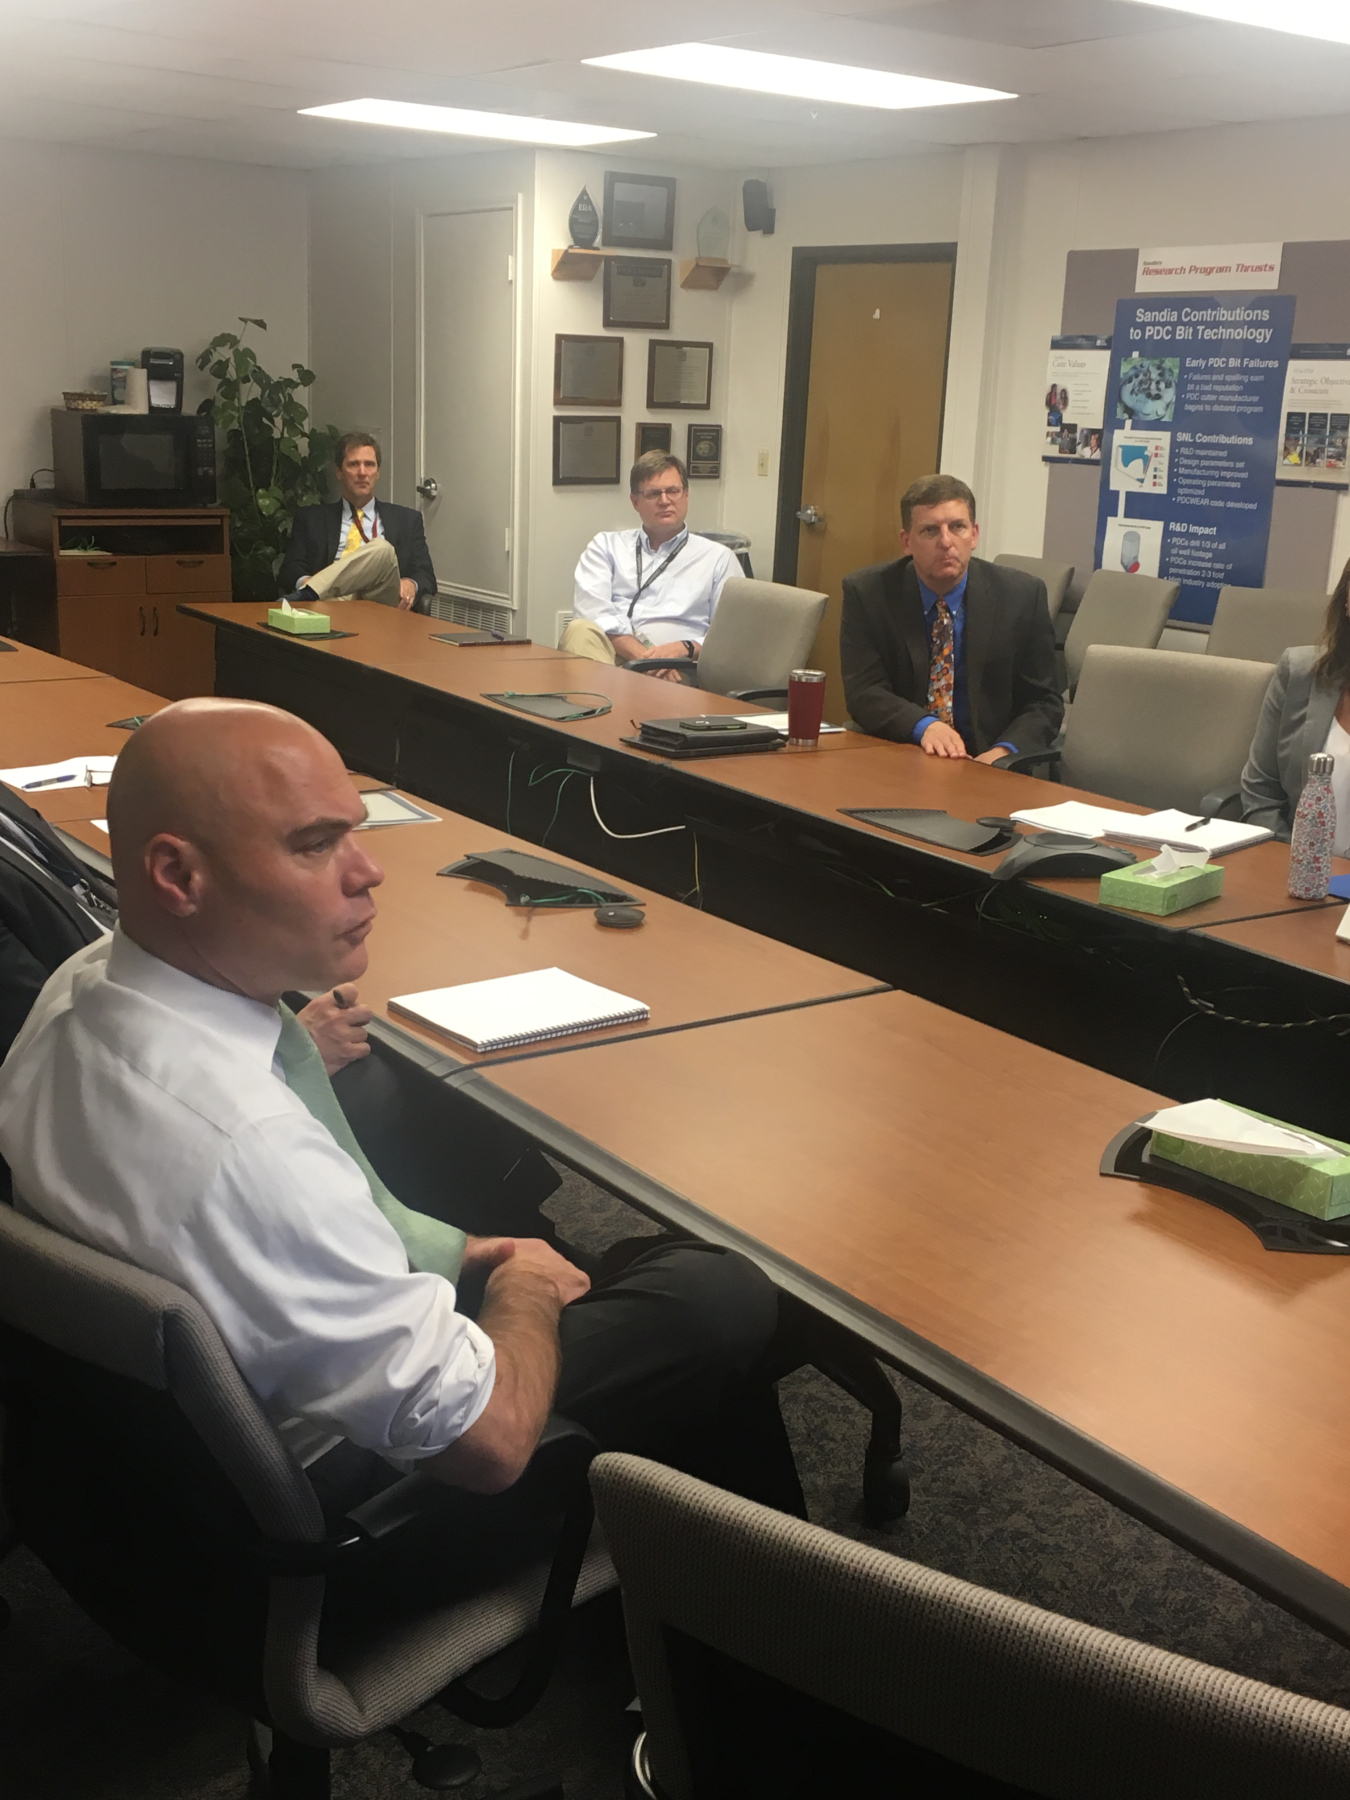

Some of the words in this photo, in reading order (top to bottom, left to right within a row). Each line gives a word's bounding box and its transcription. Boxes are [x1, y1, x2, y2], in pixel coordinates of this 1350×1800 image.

[1142, 266, 1186, 275] Research
[1188, 265, 1231, 276] Program
[1236, 263, 1275, 272] Thrusts
[1135, 308, 1178, 322] Sandia
[1181, 307, 1269, 321] Contributions
[1130, 327, 1141, 339] to
[1145, 326, 1172, 340] PDC
[1176, 326, 1193, 340] Bit
[1197, 325, 1273, 343] Technology
[1052, 360, 1066, 368] Core
[1068, 360, 1086, 368] Values
[1185, 358, 1207, 369] Early
[1208, 358, 1226, 367] PDC
[1228, 358, 1241, 367] Bit
[1243, 358, 1279, 368] Failures
[1291, 376, 1318, 387] Strategic
[1290, 386, 1296, 394] &
[1298, 386, 1329, 395] Crosscuts
[1219, 394, 1259, 402] manufacturer
[1184, 404, 1203, 412] begins
[1237, 406, 1263, 414] program
[1177, 432, 1193, 442] SNL
[1196, 433, 1253, 445] Contributions
[1195, 448, 1227, 457] maintained
[1179, 458, 1199, 466] Design
[1235, 460, 1245, 468] set
[1178, 467, 1219, 477] Manufacturing
[1221, 470, 1248, 478] improved
[1178, 477, 1206, 487] Operating
[1207, 480, 1241, 488] parameters
[1177, 488, 1205, 496] optimized
[1176, 496, 1209, 506] PDCWEAR
[1210, 499, 1225, 507] code
[1226, 500, 1257, 510] developed
[1169, 522, 1187, 532] R&D
[1189, 524, 1217, 535] Impact
[1171, 537, 1188, 546] PDCs
[1190, 539, 1200, 547] drill
[1191, 549, 1213, 559] footage
[1170, 557, 1187, 565] PDCs
[1188, 560, 1211, 568] increase
[1169, 567, 1200, 576] penetration
[1213, 571, 1224, 579] fold
[1182, 578, 1205, 588] industry
